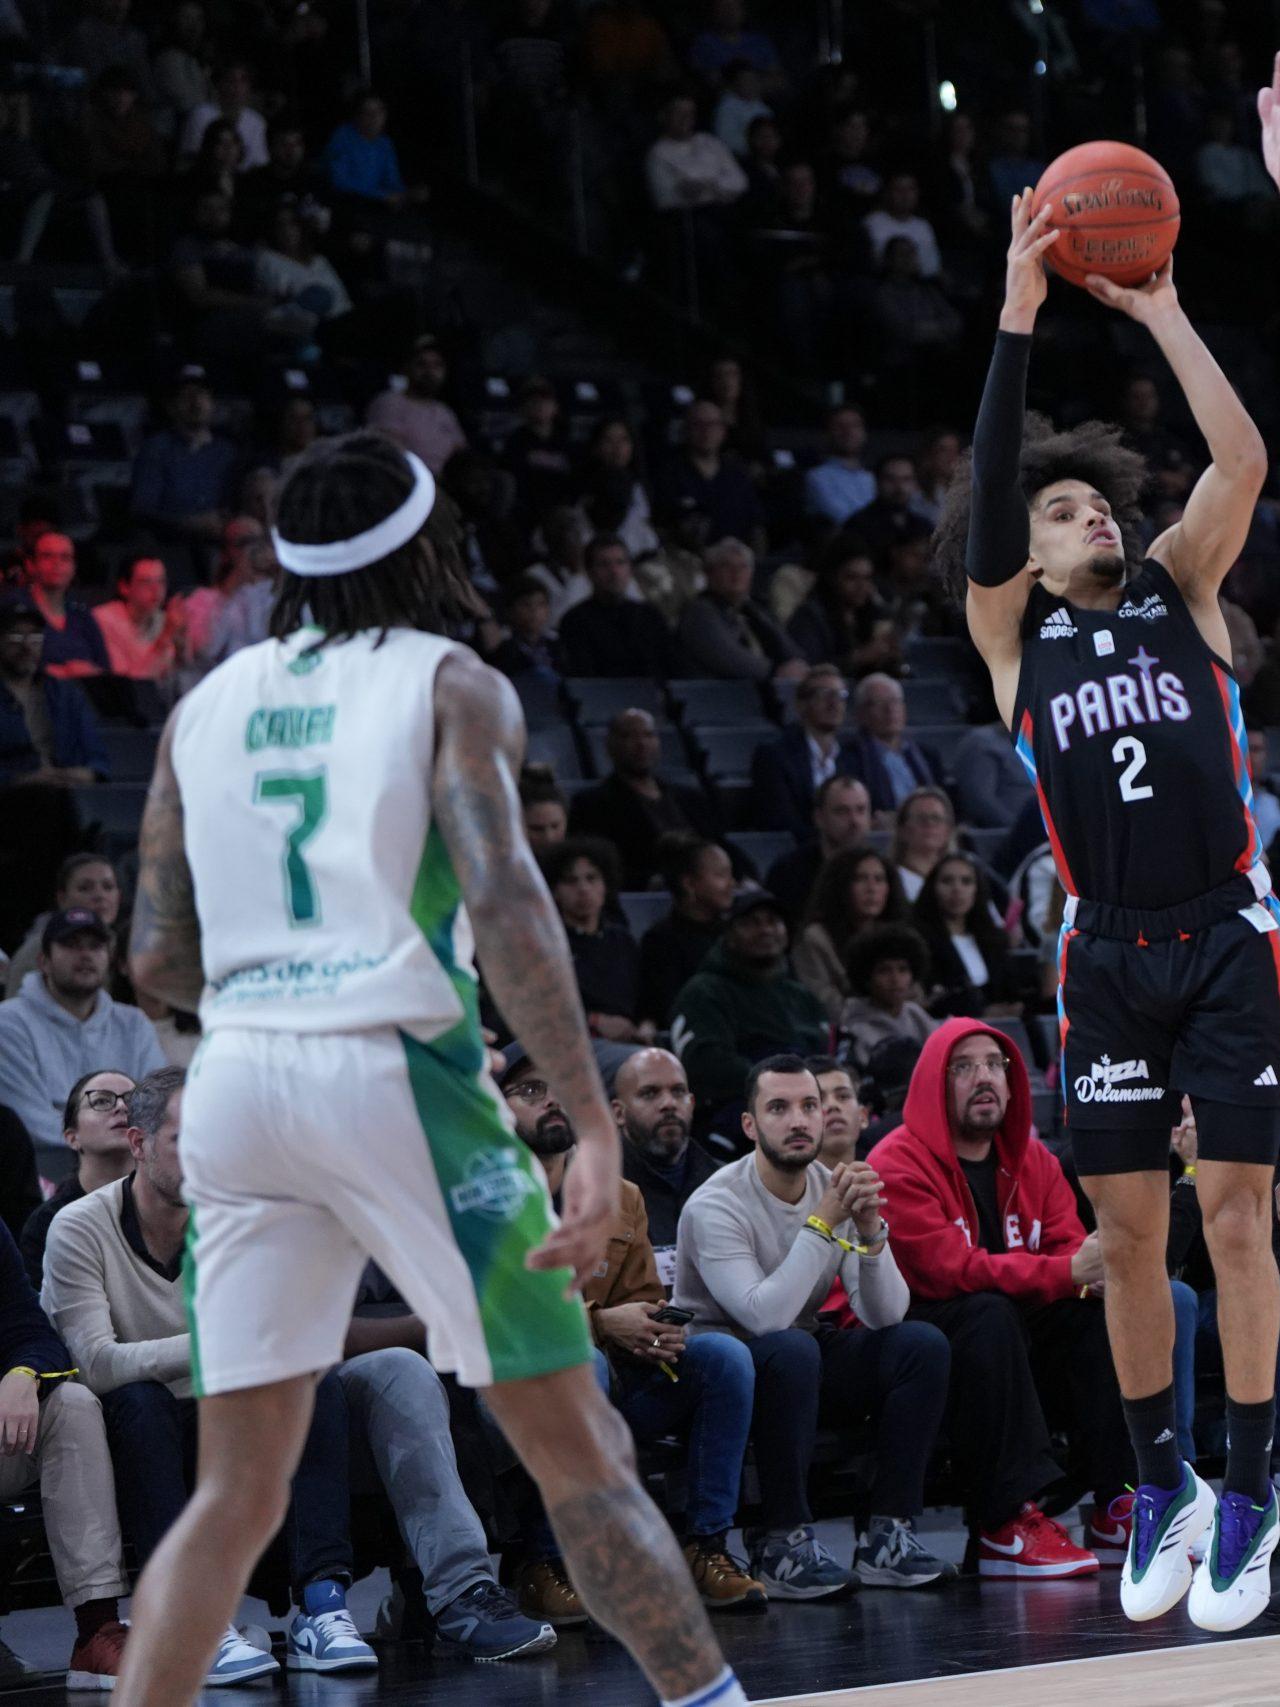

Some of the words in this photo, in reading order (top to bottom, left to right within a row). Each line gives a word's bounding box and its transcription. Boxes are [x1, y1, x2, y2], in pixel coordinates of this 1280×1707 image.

[1050, 670, 1192, 753] PARIS
[1111, 735, 1154, 803] 2
[252, 763, 330, 932] 7
[1074, 1075, 1166, 1103] Delamama
[1091, 1059, 1150, 1084] PIZZA
